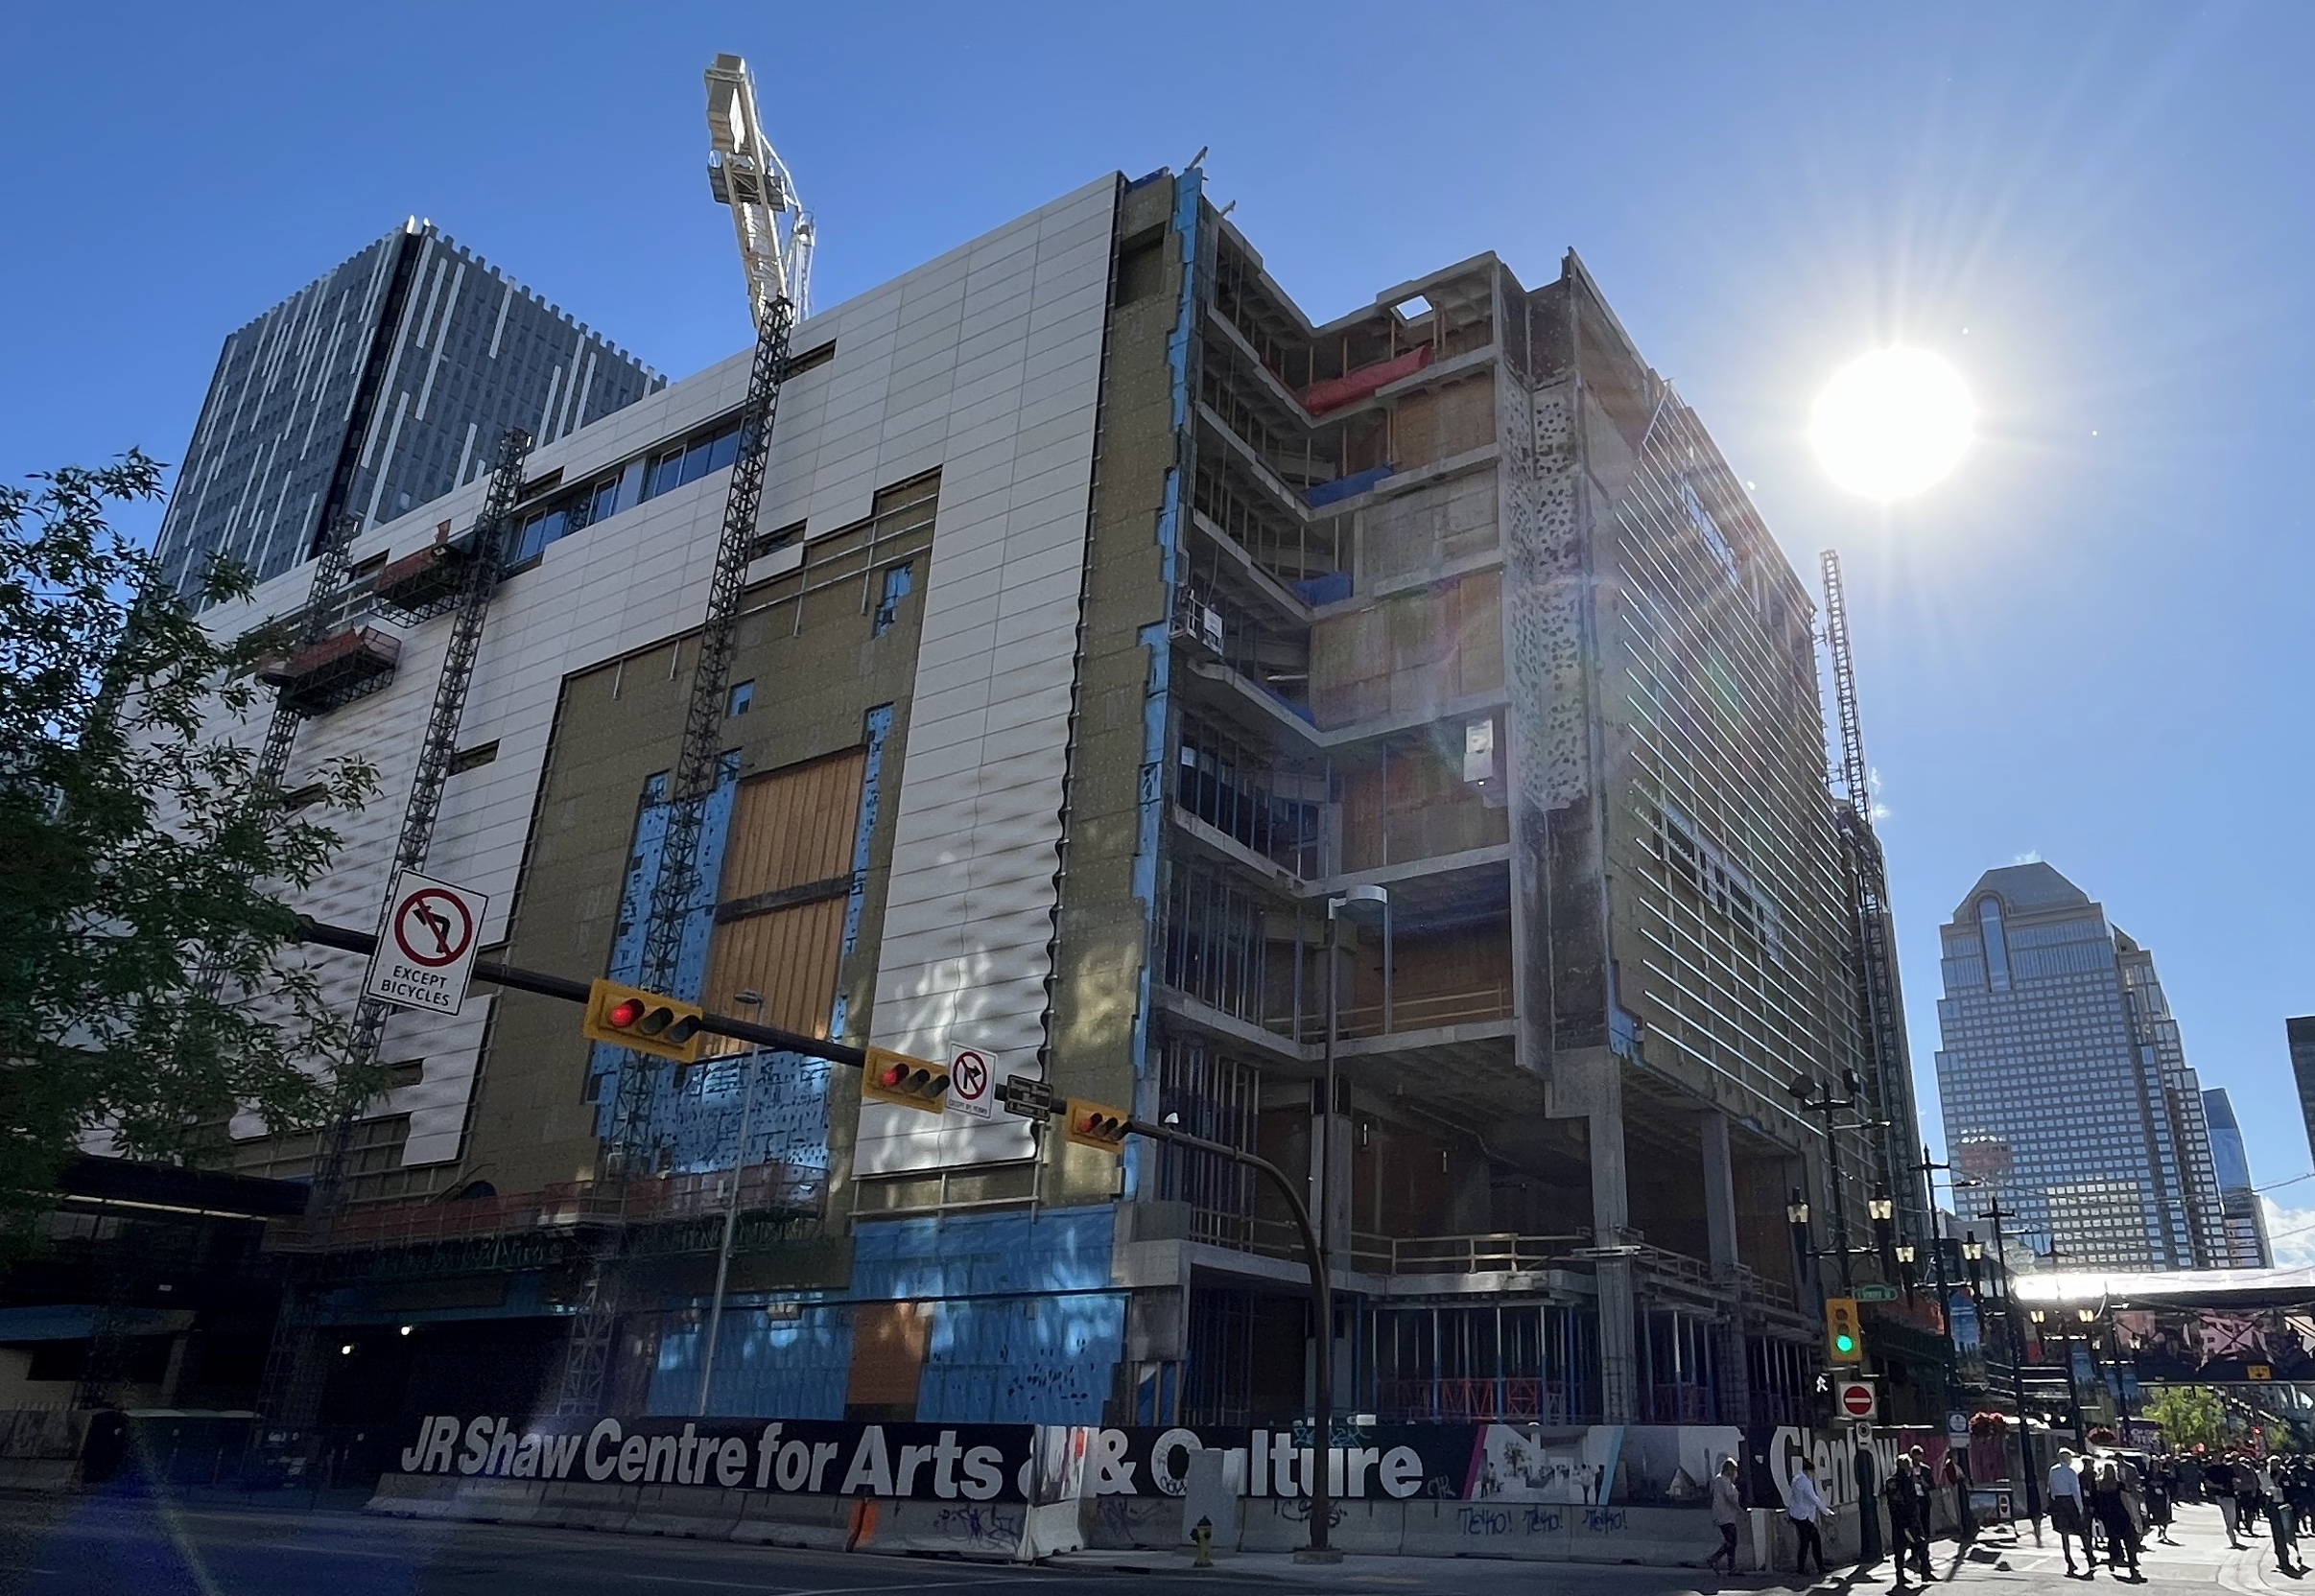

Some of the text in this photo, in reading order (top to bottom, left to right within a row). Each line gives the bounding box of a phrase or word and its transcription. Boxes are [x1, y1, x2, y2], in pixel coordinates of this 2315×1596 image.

[392, 965, 447, 989] EXCEPT
[381, 979, 450, 1006] BICYCLES
[401, 1415, 461, 1472] JR
[459, 1417, 583, 1480] Shaw
[584, 1418, 745, 1487] Centre
[757, 1422, 835, 1491] for
[840, 1425, 1004, 1501] Arts
